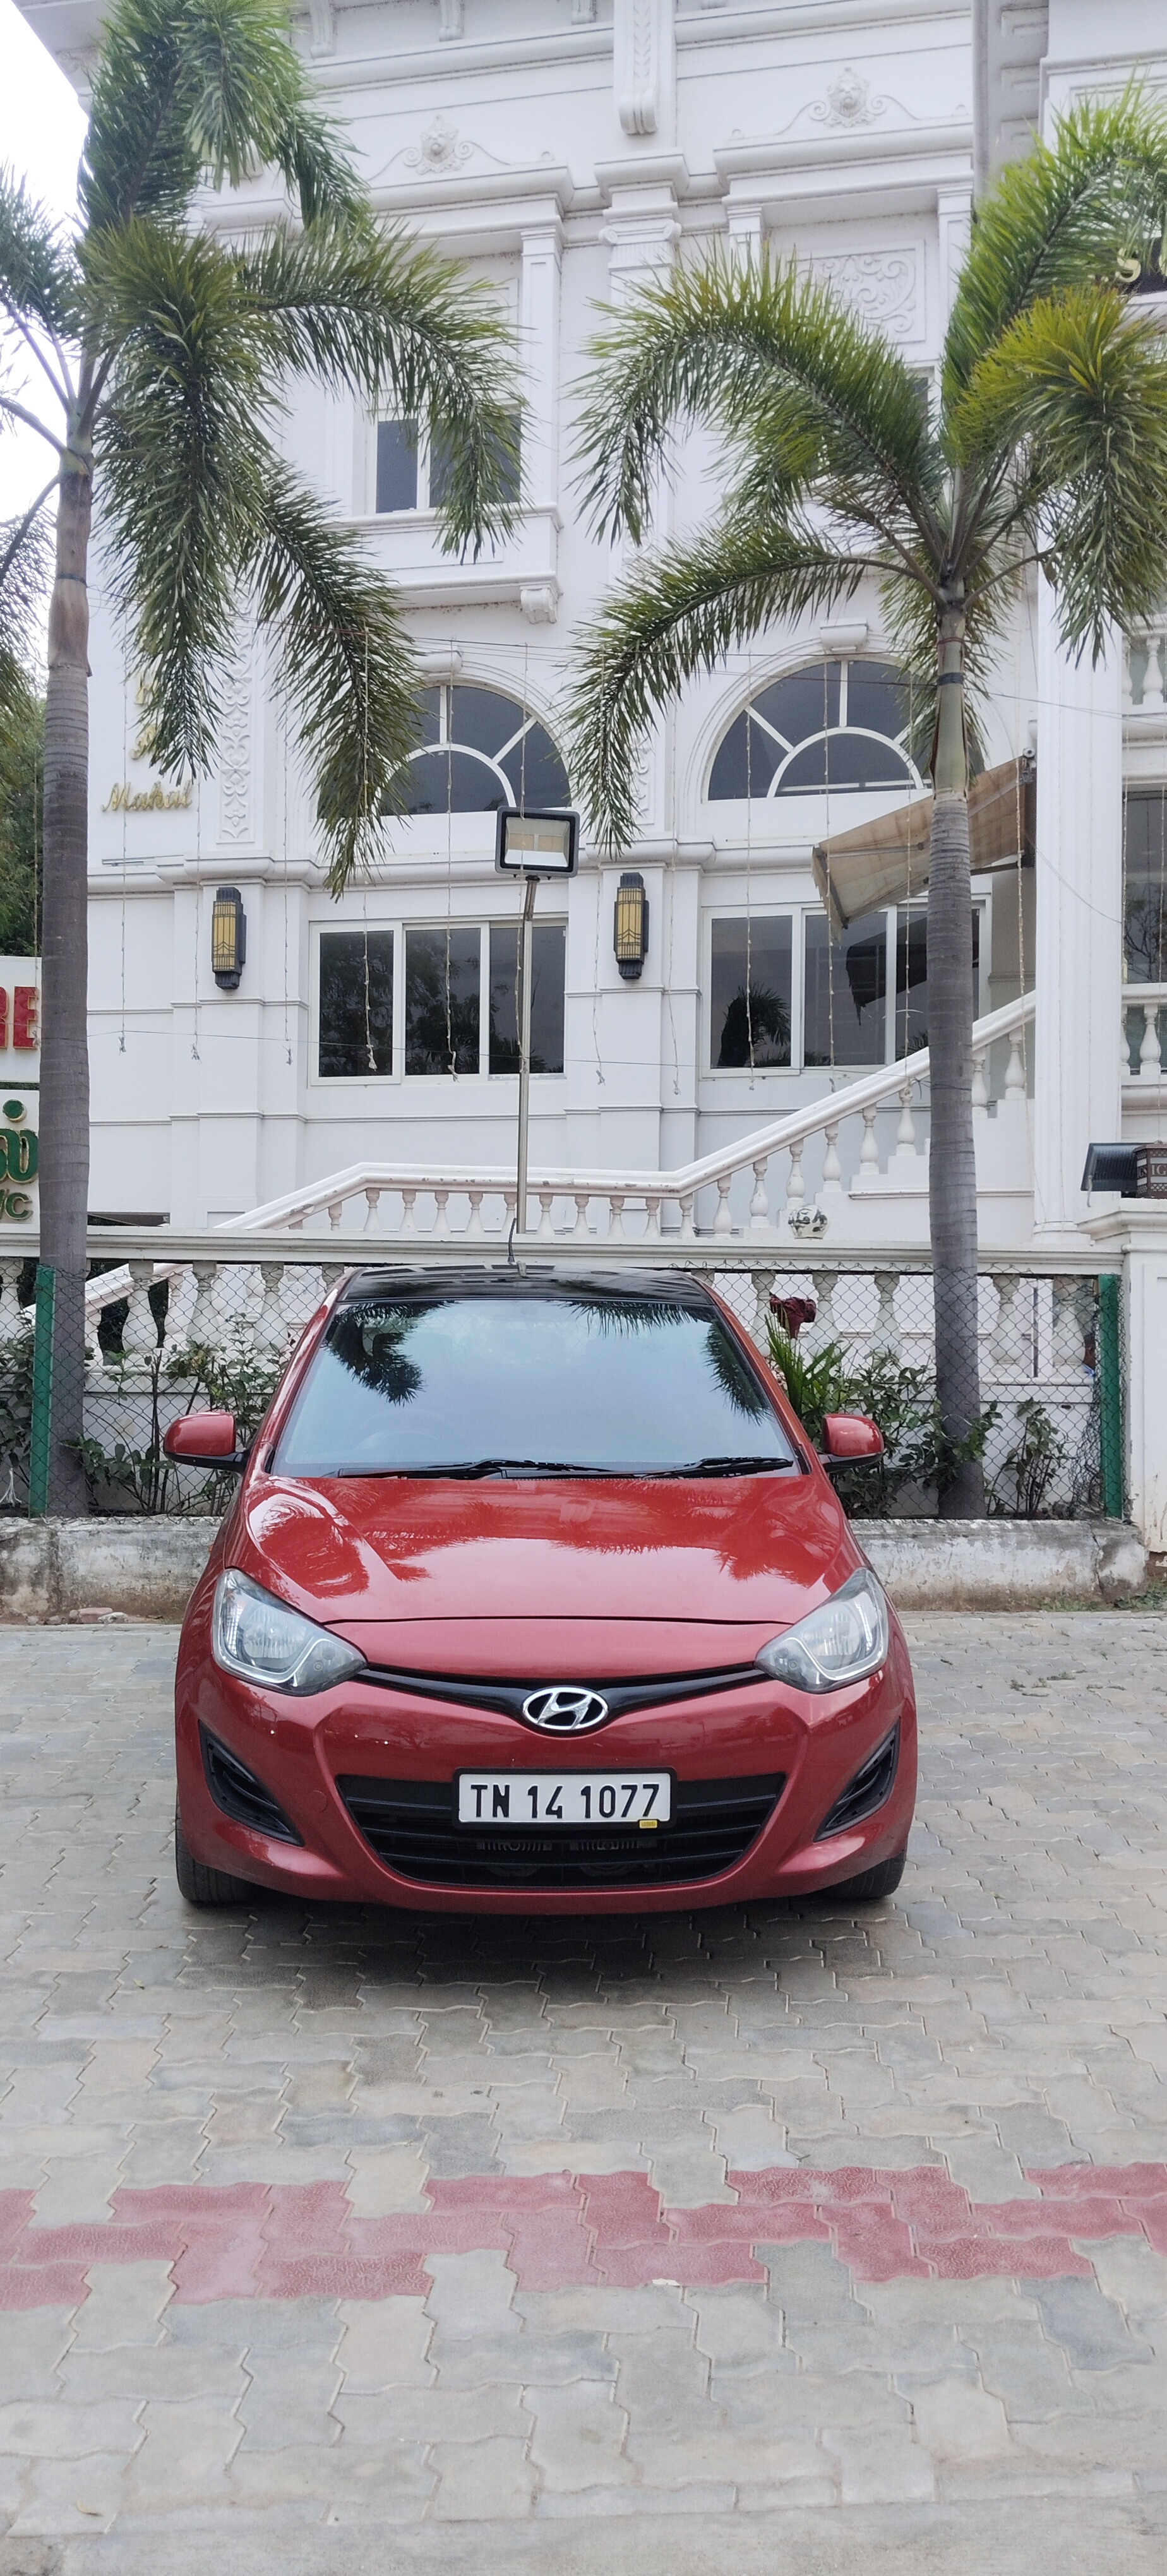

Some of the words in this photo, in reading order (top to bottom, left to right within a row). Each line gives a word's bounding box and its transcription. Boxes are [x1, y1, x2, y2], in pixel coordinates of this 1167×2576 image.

[100, 780, 193, 812] Mahal
[470, 1784, 510, 1818] TN
[527, 1785, 563, 1819] 14
[580, 1784, 660, 1818] 1077
